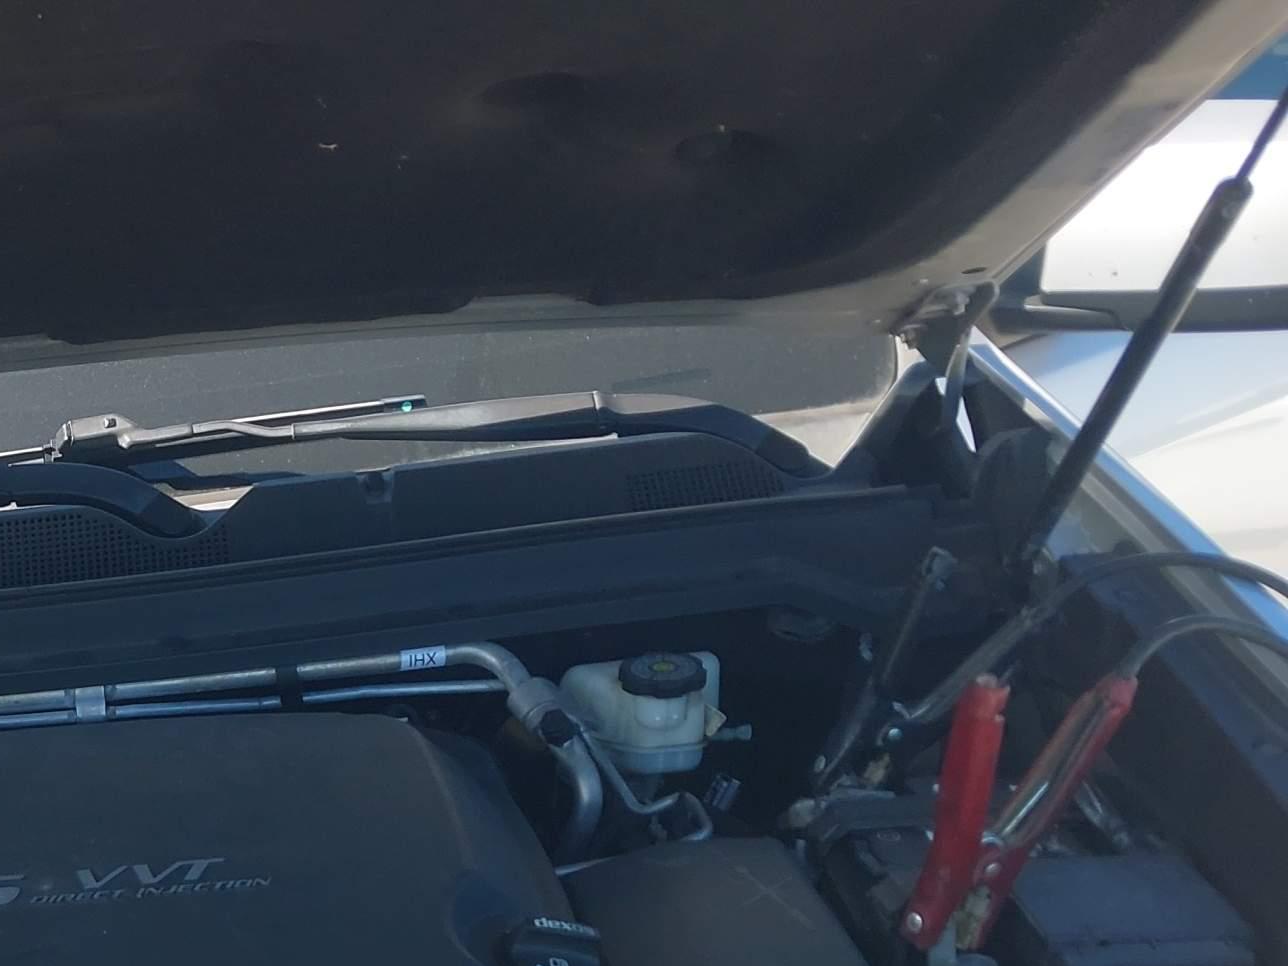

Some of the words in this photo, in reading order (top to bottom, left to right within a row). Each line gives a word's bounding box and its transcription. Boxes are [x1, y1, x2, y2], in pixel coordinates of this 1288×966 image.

[409, 651, 437, 667] IHX
[76, 857, 225, 890] VVT
[29, 888, 125, 905] DIRECT
[136, 876, 271, 899] INJECTION
